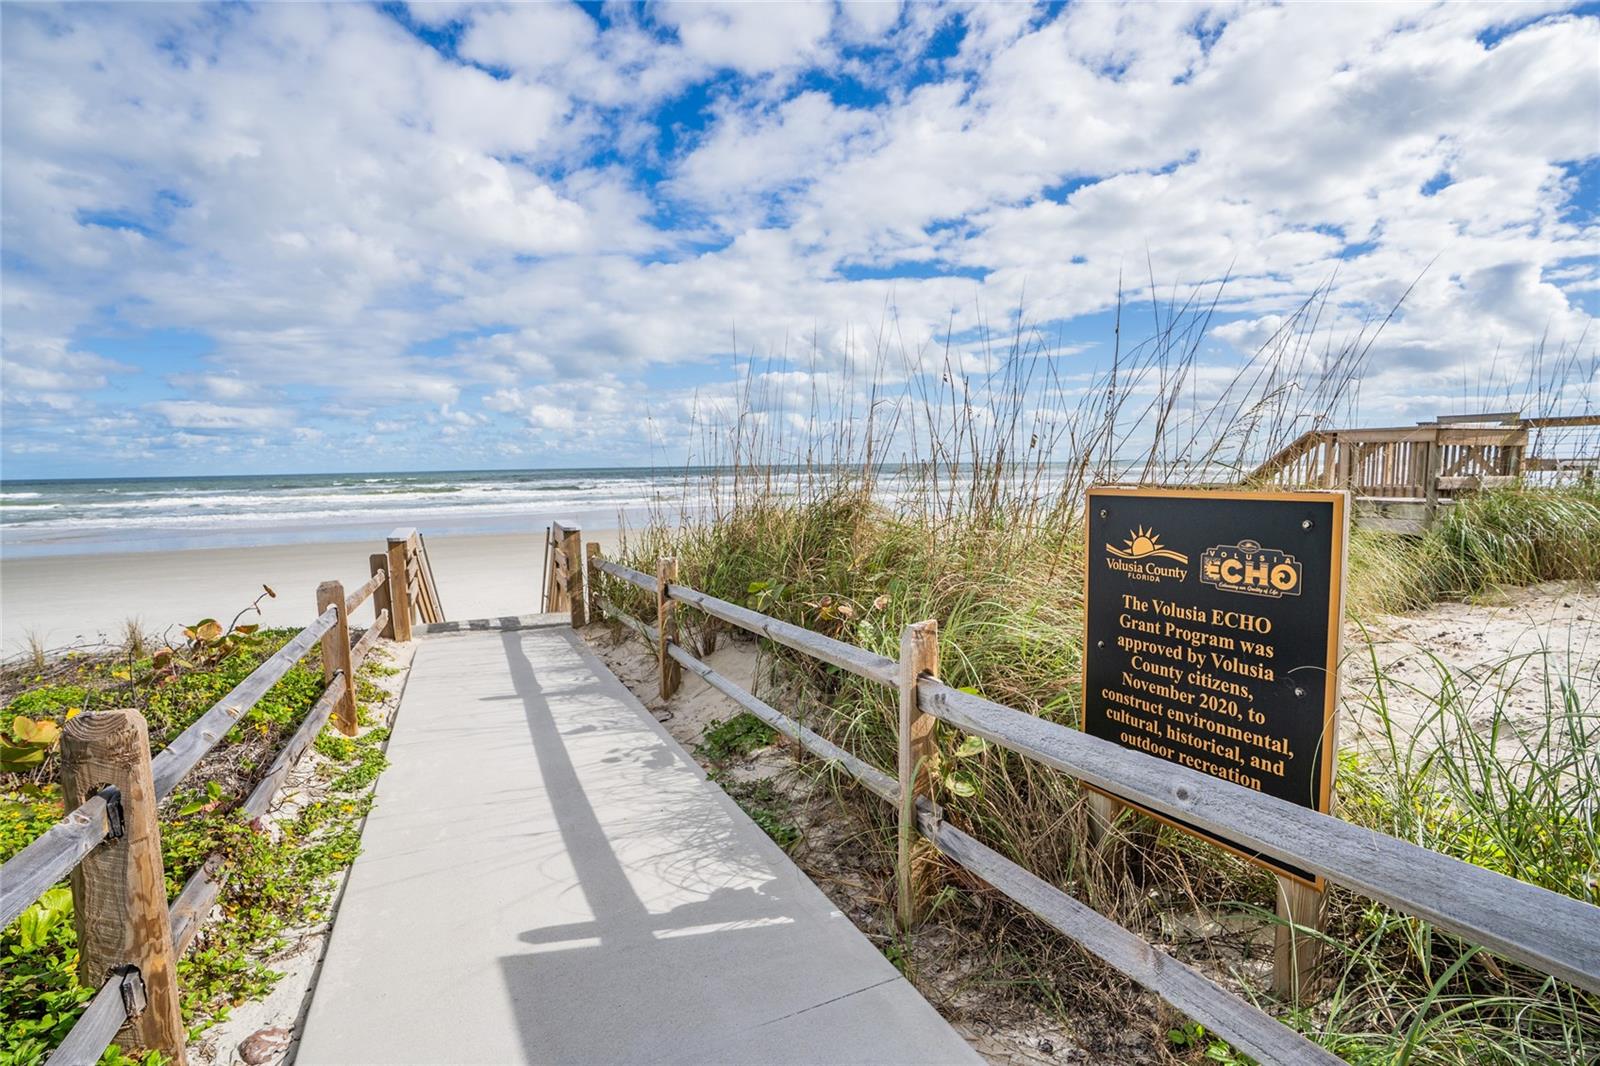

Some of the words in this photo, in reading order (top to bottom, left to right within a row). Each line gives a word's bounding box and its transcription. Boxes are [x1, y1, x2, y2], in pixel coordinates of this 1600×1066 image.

[1106, 557, 1143, 573] Volusia
[1145, 562, 1188, 583] County
[1127, 572, 1161, 583] FLORIDA
[1204, 559, 1297, 590] ECHO
[1209, 550, 1291, 564] VOLUSIA
[1119, 613, 1161, 635] Grant
[1165, 622, 1235, 650] Program
[1240, 640, 1274, 658] was
[1122, 594, 1148, 612] The
[1152, 599, 1206, 622] Volusia
[1211, 609, 1272, 634] ECHO
[1117, 635, 1182, 660] approved
[1187, 648, 1206, 669] by
[1211, 653, 1274, 682] Volusia
[1131, 655, 1183, 684] County
[1187, 673, 1254, 701] citizens,
[1122, 671, 1195, 705] November
[1199, 694, 1243, 721] 2020,
[1248, 707, 1266, 725] to
[1101, 687, 1163, 716] construct
[1167, 709, 1294, 760] environmental,
[1106, 707, 1162, 738] cultural,
[1166, 724, 1245, 766] historical,
[1250, 755, 1285, 777] and
[1120, 730, 1175, 760] outdoor
[1178, 751, 1262, 792] recreation
